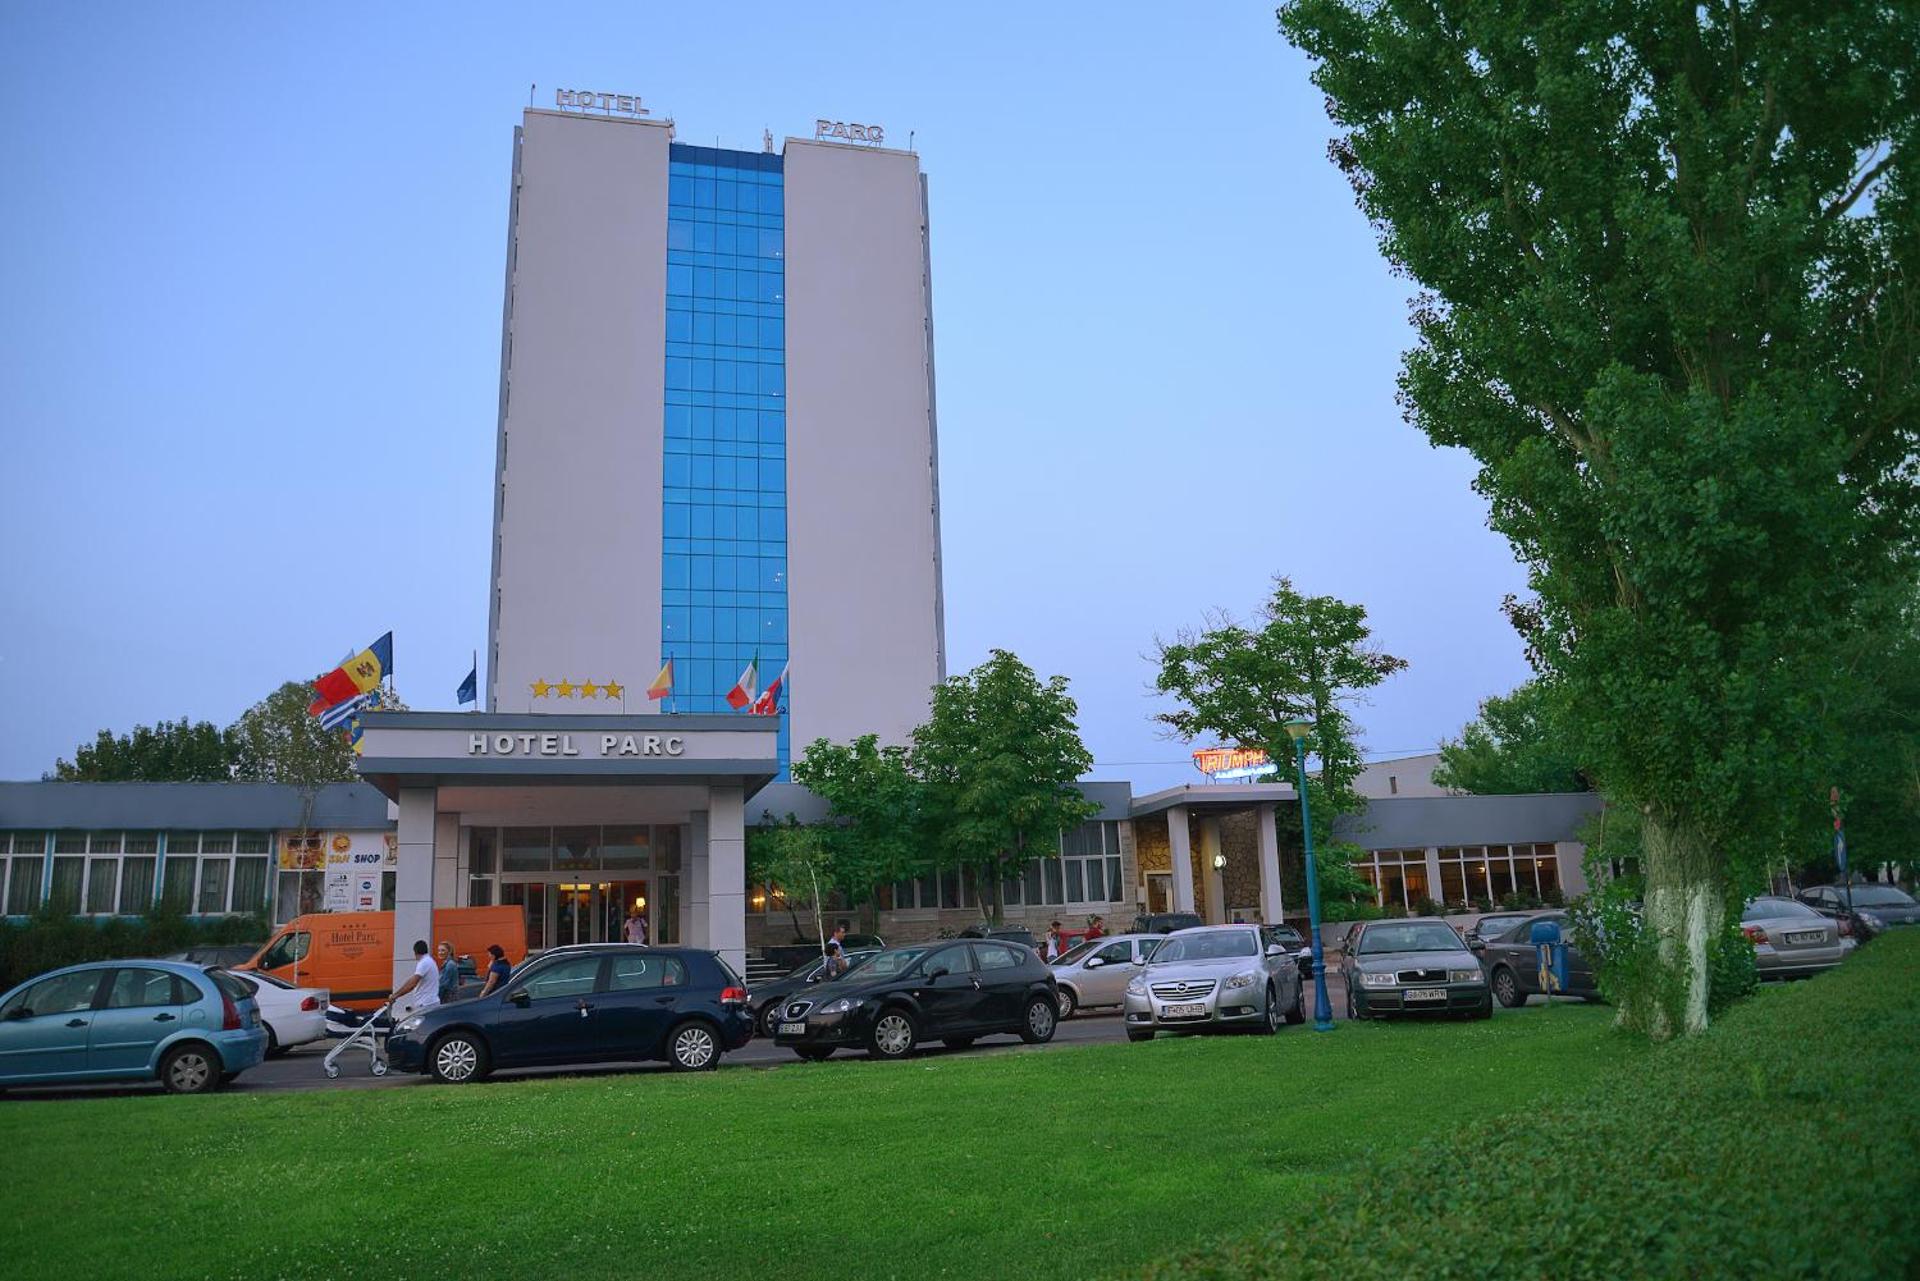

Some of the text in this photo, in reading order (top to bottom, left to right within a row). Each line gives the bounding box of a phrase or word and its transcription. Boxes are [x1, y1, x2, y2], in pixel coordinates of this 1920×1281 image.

[556, 88, 650, 115] HOTEL
[816, 120, 885, 142] PARC
[468, 733, 685, 756] HOTEL PARC
[1193, 749, 1266, 773] TRIUMPH
[354, 854, 381, 864] SHOP
[331, 931, 354, 944] Hotel
